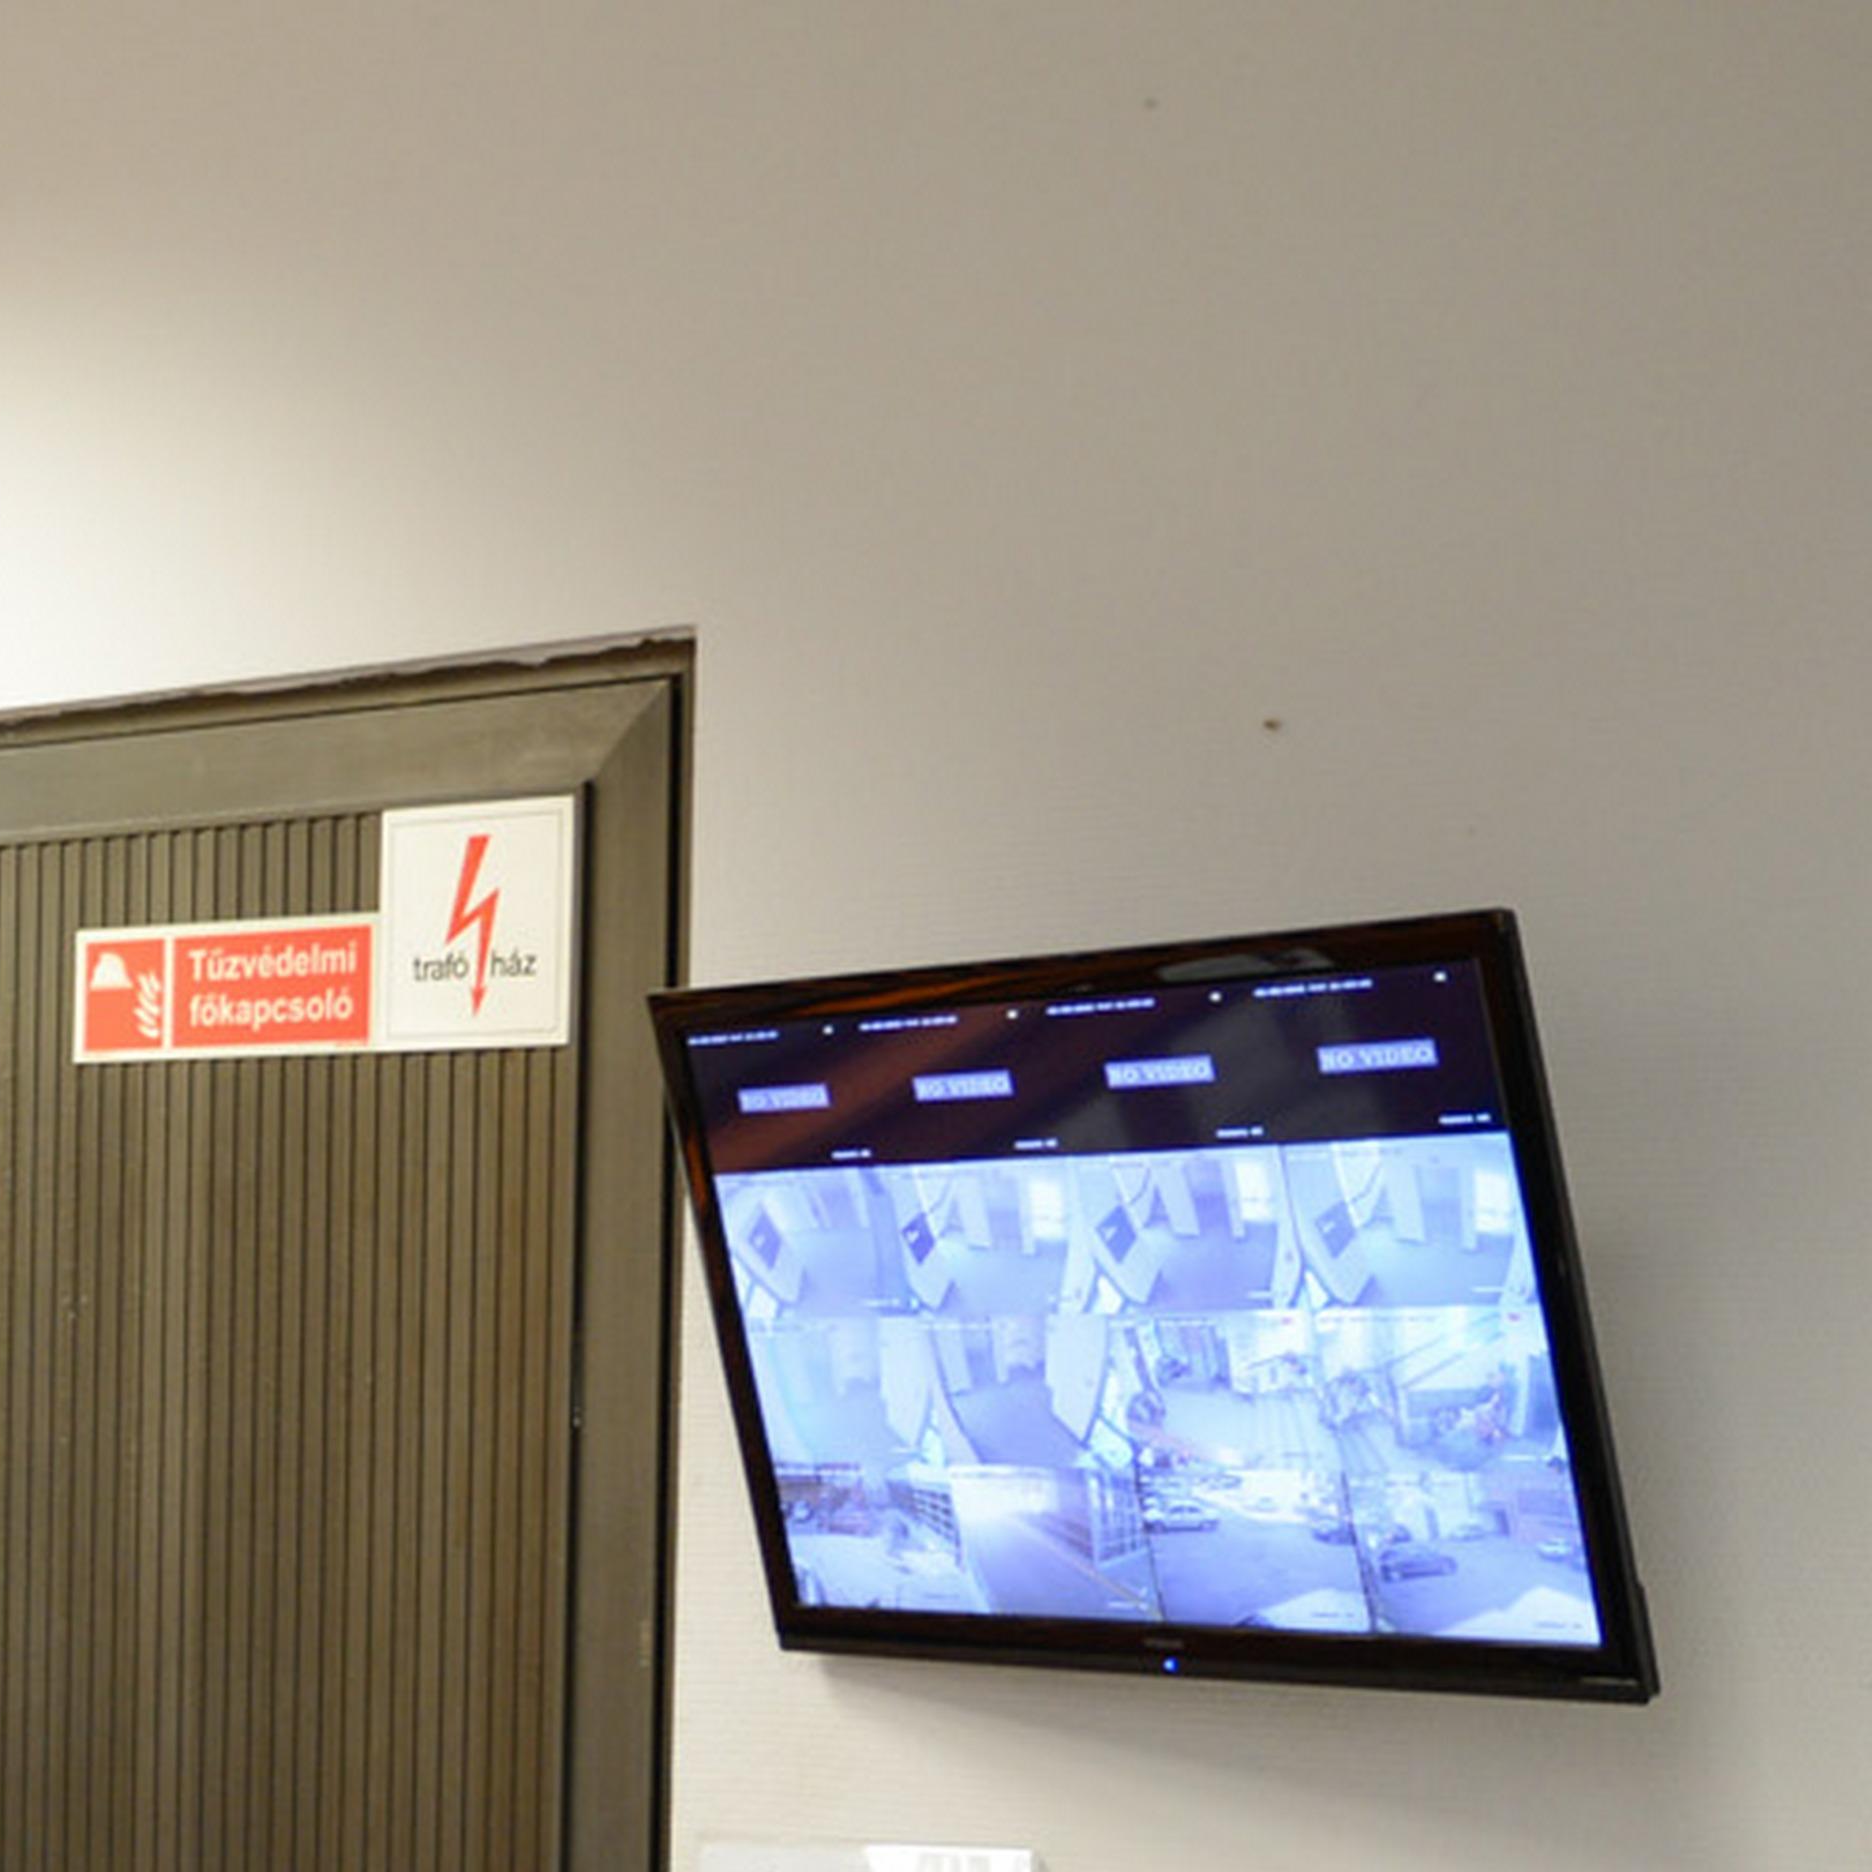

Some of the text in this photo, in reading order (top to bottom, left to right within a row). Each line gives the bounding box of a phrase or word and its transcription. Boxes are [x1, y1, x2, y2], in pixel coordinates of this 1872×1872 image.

[188, 939, 357, 982] Tűzvédelmi
[413, 946, 537, 982] trafó ház
[189, 988, 354, 1029] főkapcsoló
[1321, 1043, 1435, 1070] NO VIDEO
[917, 1071, 1011, 1099] NO VIDEO
[1108, 1059, 1212, 1086] NO VIDEO
[741, 1085, 828, 1110] NO VIDEO
